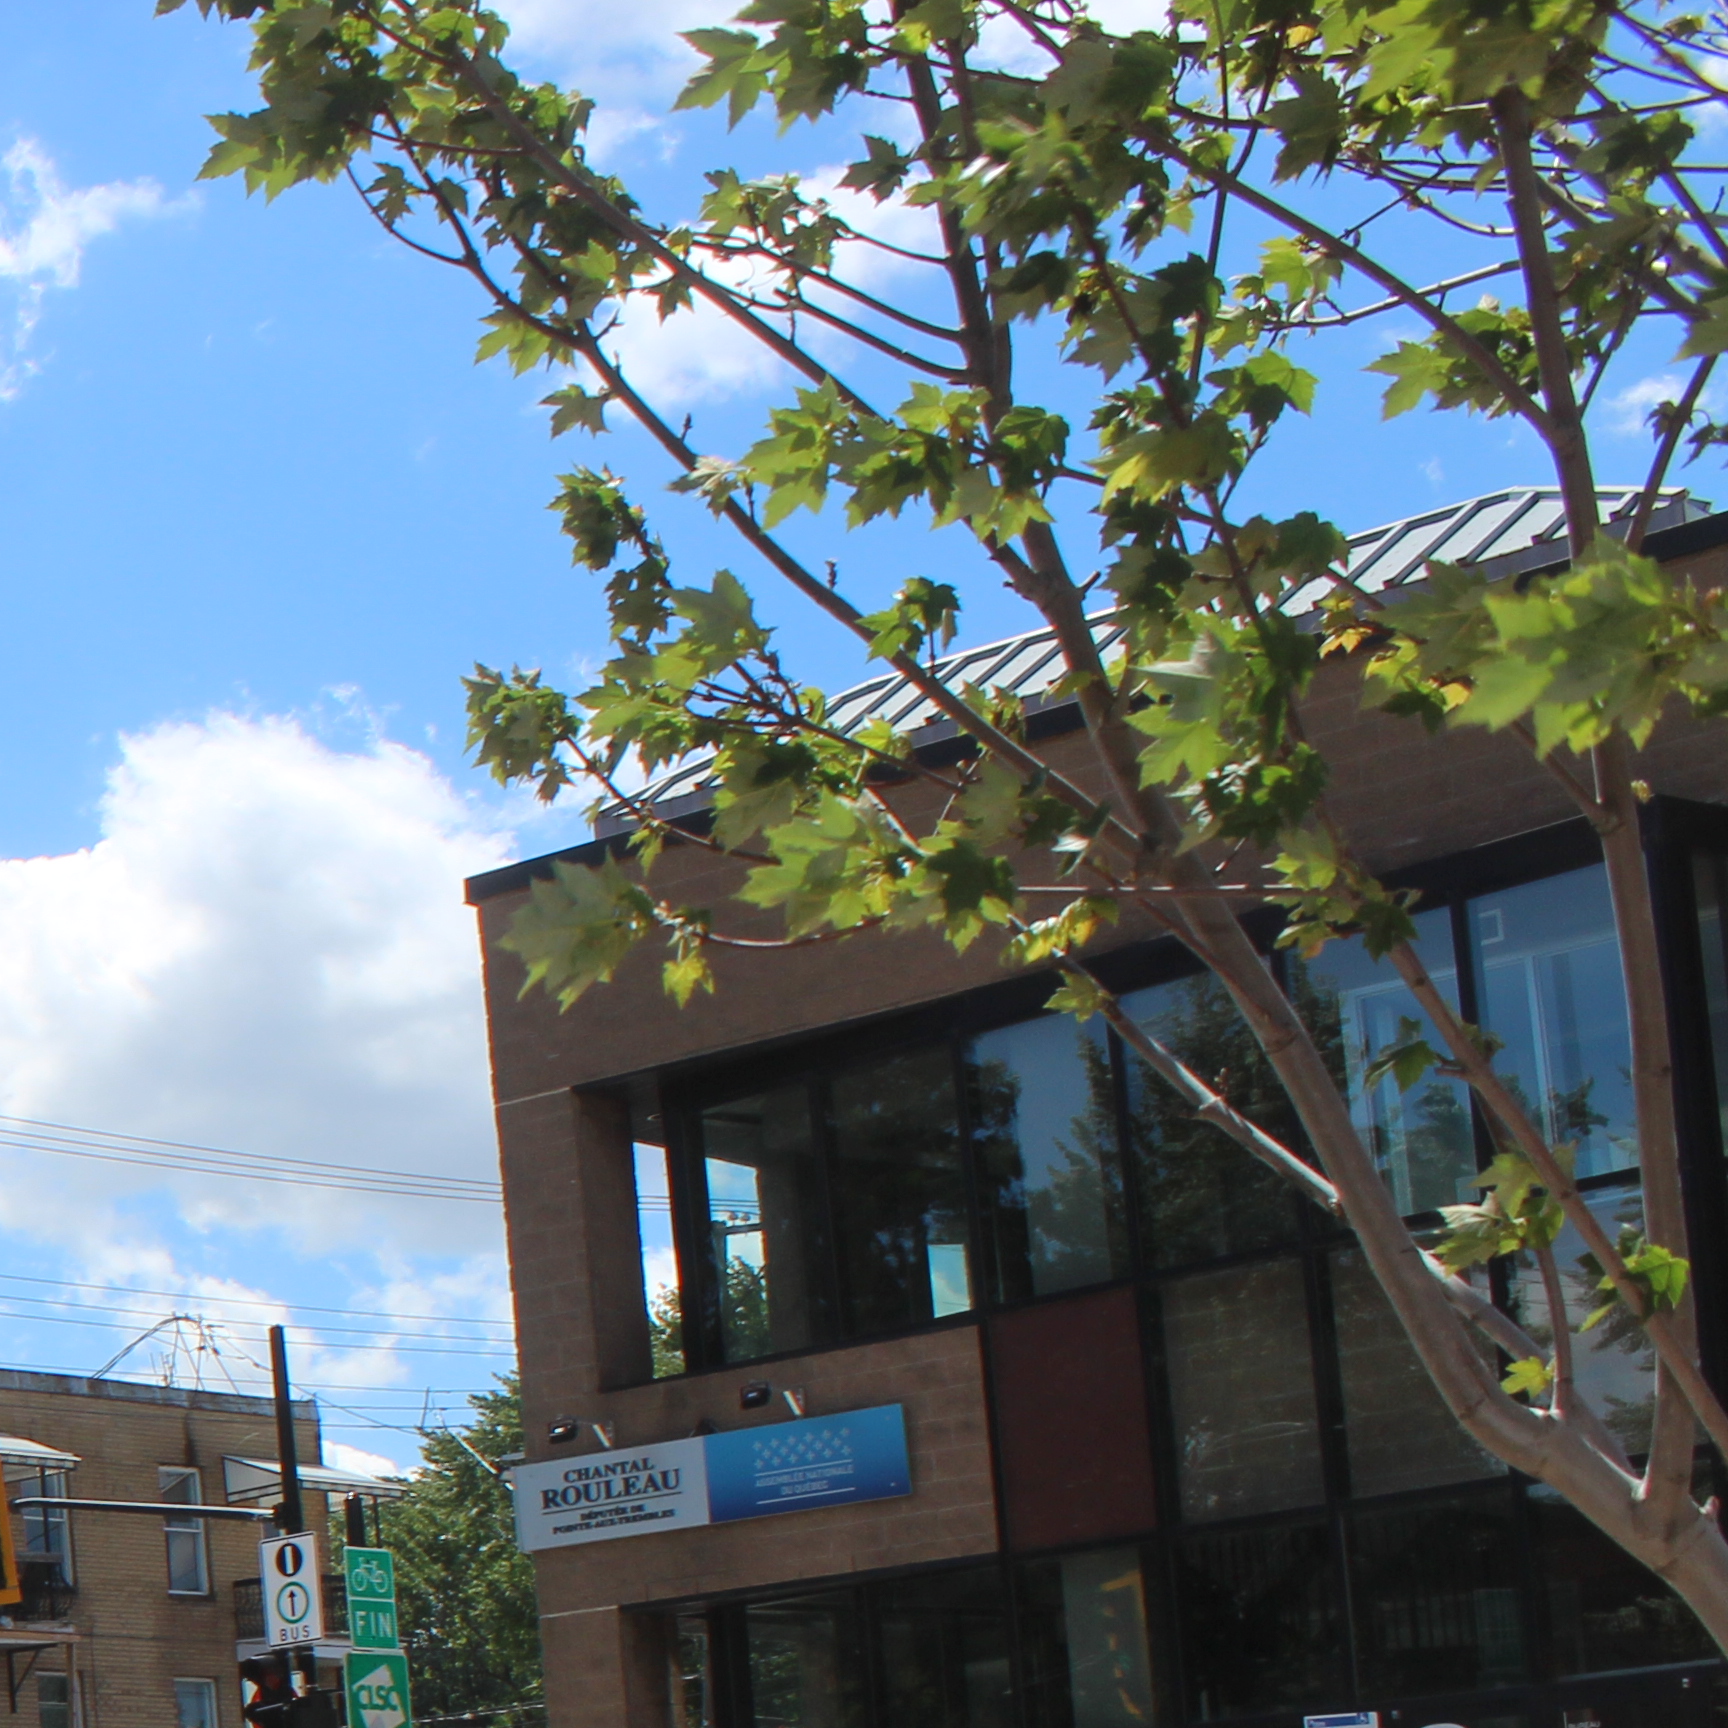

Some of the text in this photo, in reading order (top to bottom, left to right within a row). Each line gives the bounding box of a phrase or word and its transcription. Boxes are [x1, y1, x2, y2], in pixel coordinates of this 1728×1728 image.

[562, 1457, 655, 1483] CHANTAL
[540, 1468, 680, 1510] ROULEAU
[280, 1625, 310, 1642] BUS
[355, 1611, 392, 1637] FIN
[352, 1684, 400, 1711] CLSC
